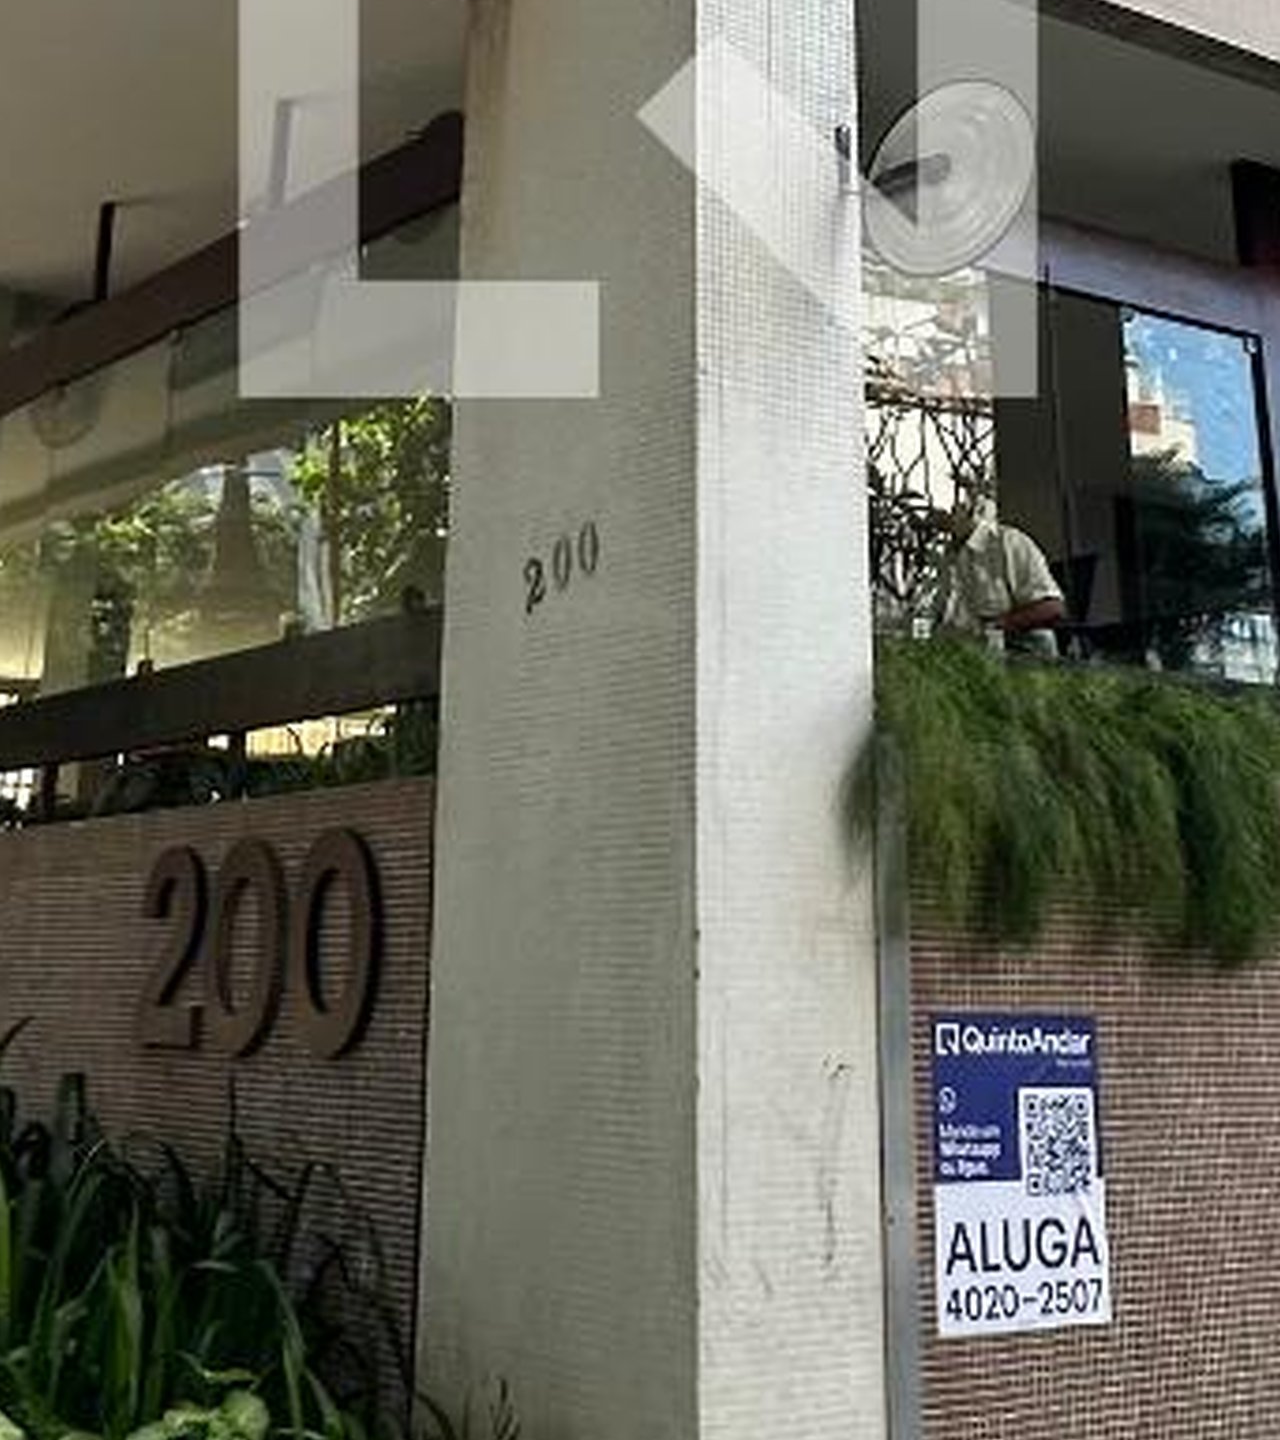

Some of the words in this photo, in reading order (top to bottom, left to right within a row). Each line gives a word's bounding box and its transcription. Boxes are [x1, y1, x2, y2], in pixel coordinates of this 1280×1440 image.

[523, 521, 599, 614] 200
[136, 826, 382, 1060] 200
[962, 1025, 1091, 1055] QuintoAndar
[946, 1216, 1101, 1276] ALUGA
[946, 1278, 1103, 1321] 4020-2507
